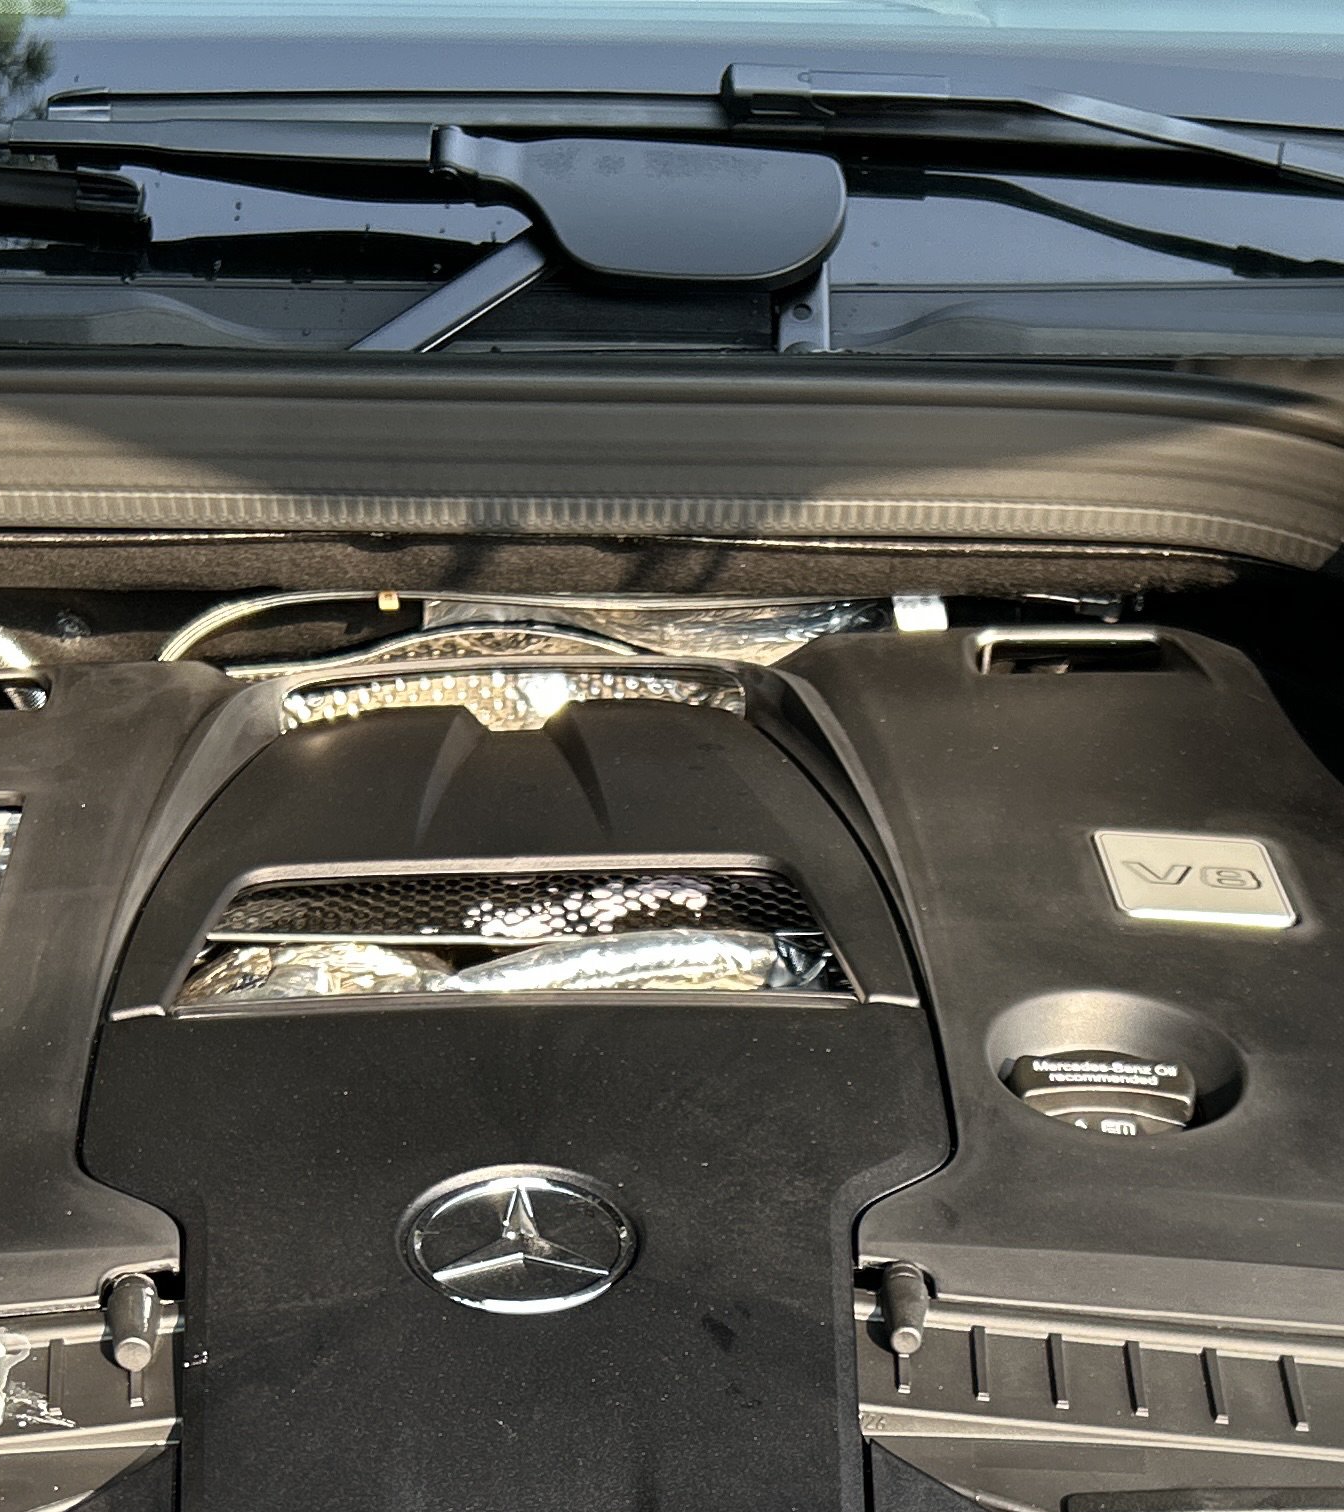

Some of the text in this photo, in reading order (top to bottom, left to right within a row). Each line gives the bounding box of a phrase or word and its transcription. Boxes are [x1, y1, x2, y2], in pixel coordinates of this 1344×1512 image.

[1121, 860, 1263, 891] V8
[1032, 1060, 1178, 1077] Mercedes-Benz Oil
[1049, 1073, 1158, 1085] recommended
